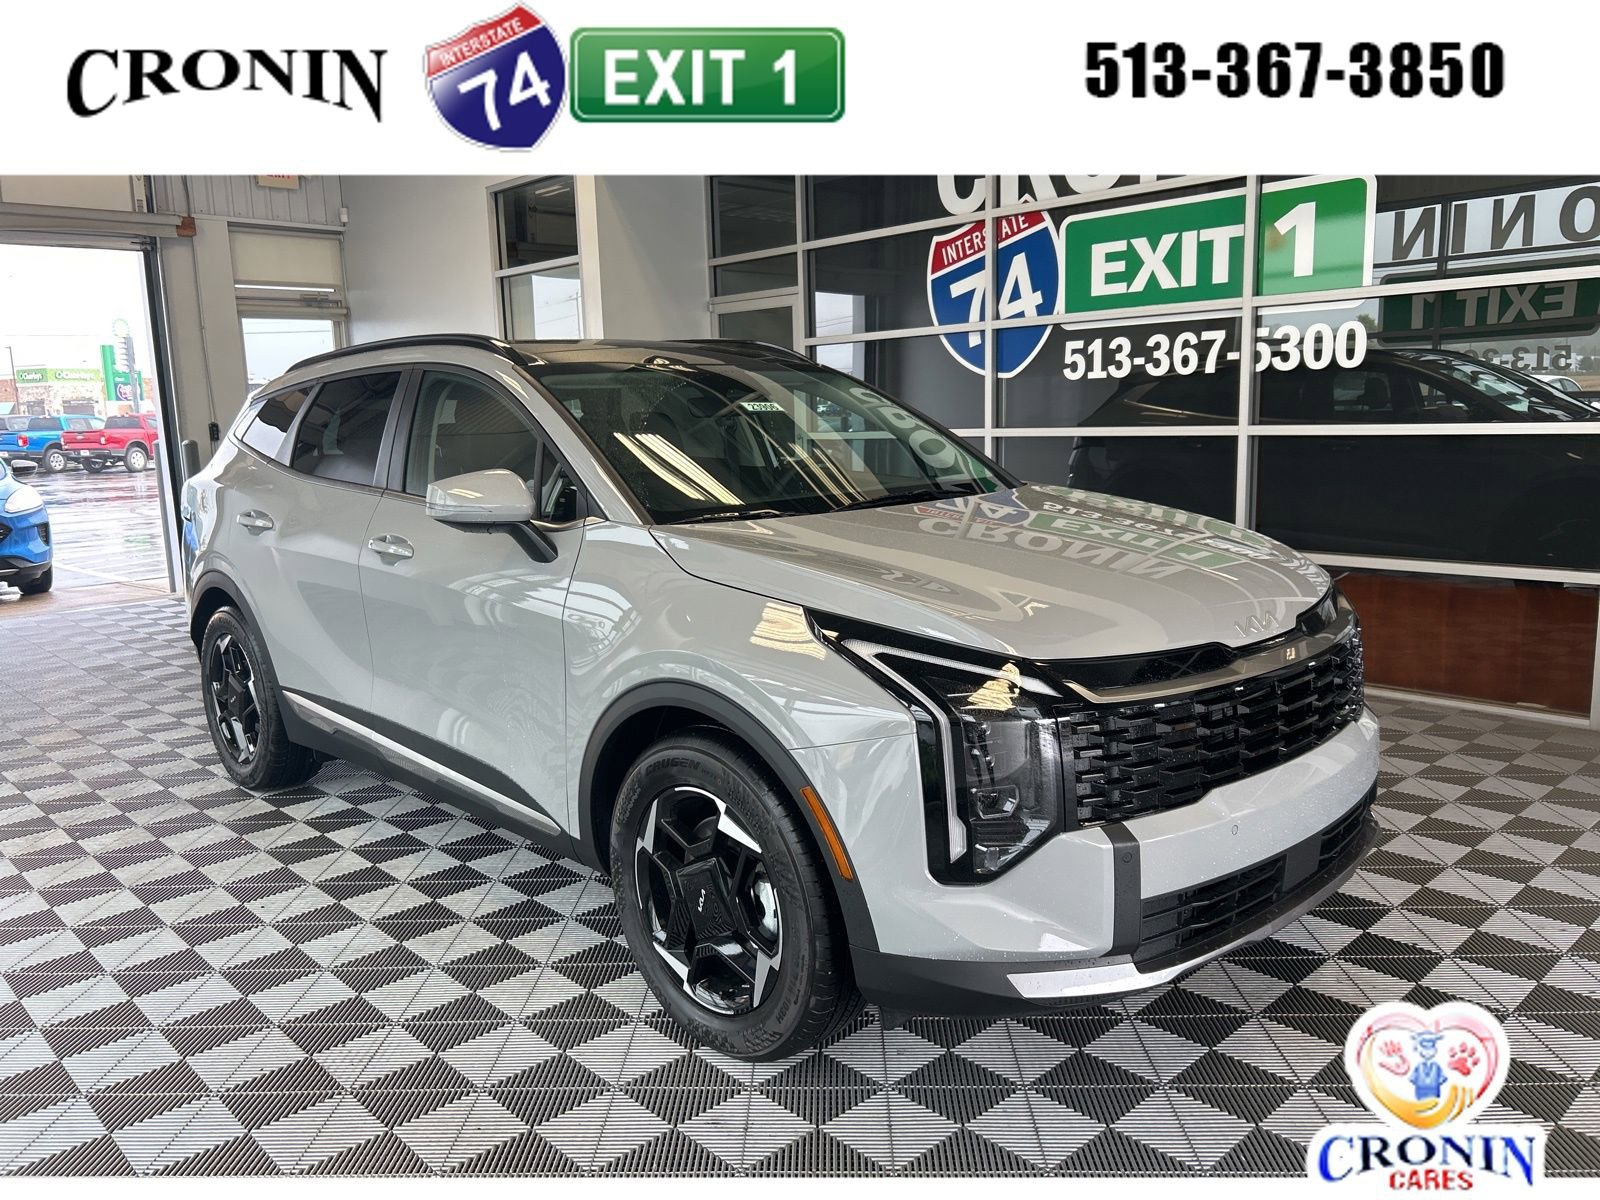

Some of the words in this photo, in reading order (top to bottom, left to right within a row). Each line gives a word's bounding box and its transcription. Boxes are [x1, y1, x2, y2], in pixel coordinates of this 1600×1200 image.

[941, 215, 1029, 266] INTERSATE
[1091, 224, 1244, 297] EXIT
[1274, 201, 1316, 278] 1
[950, 252, 1043, 348] 74
